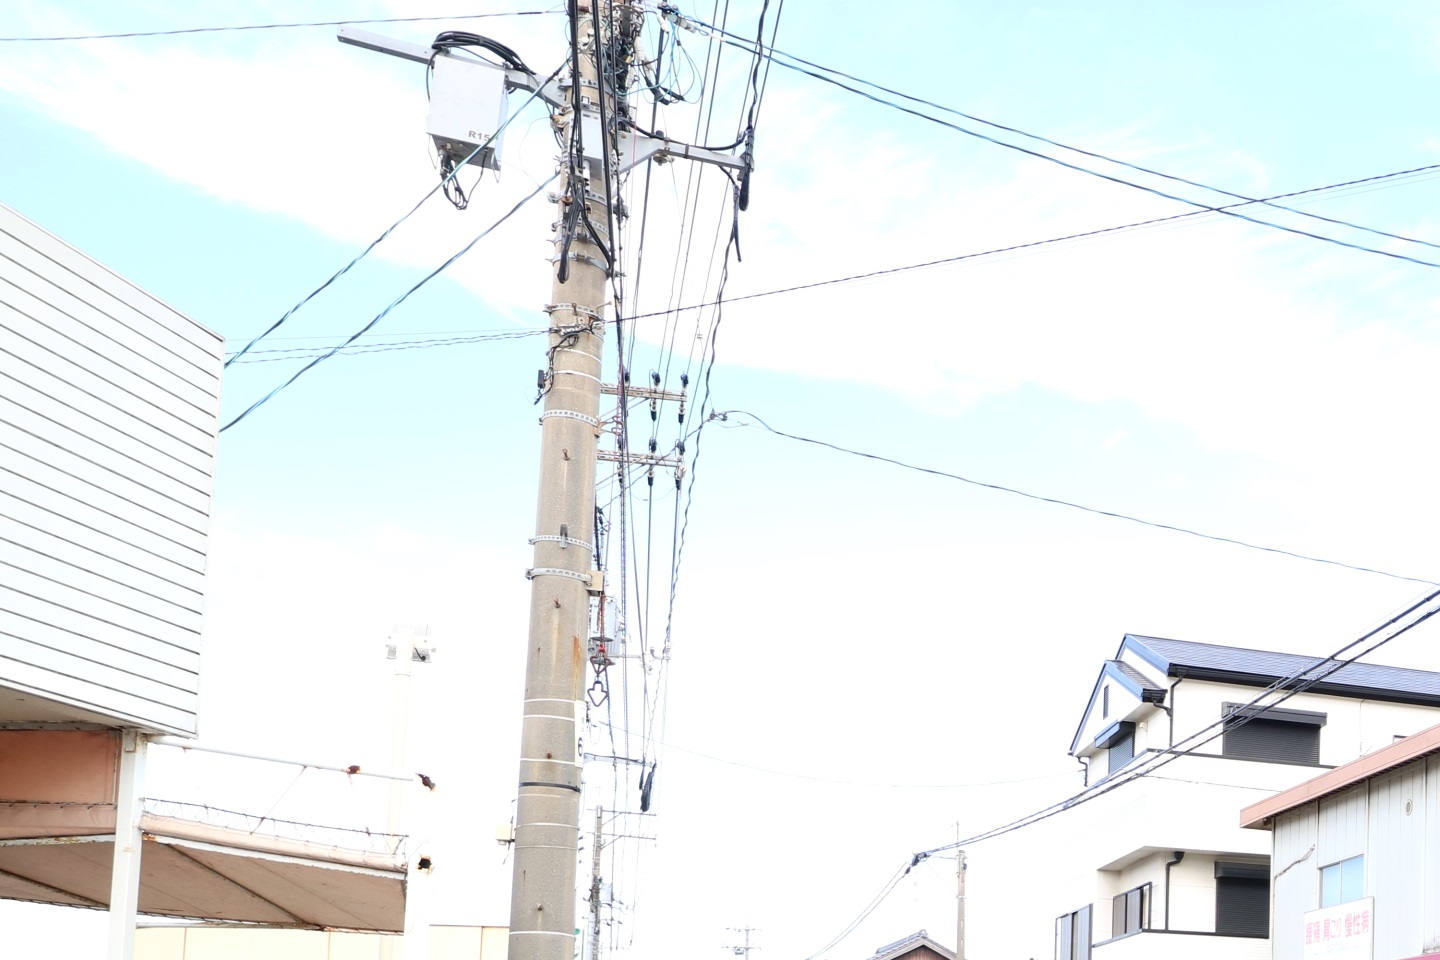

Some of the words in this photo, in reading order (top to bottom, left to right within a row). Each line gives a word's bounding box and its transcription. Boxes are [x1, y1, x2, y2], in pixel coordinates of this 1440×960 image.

[468, 130, 499, 143] R15
[1322, 917, 1342, 942] 肩こり
[1344, 910, 1370, 938] 慢性病
